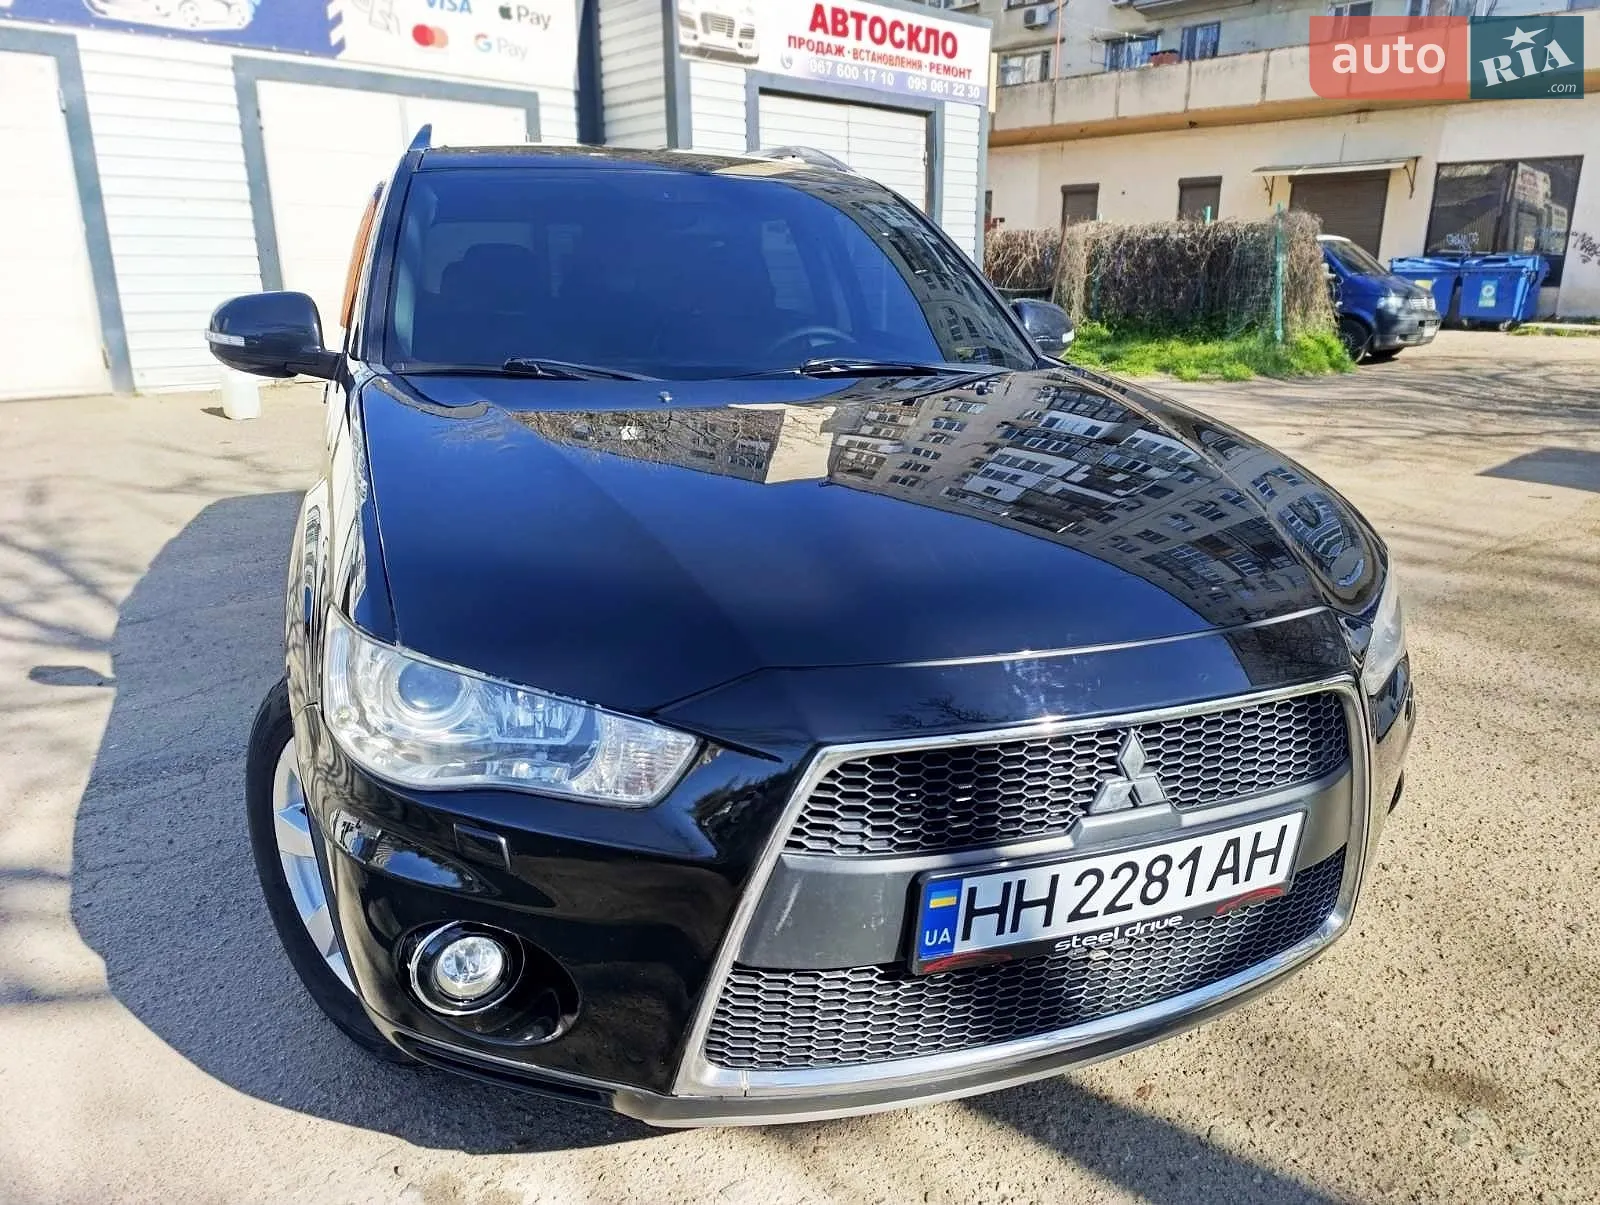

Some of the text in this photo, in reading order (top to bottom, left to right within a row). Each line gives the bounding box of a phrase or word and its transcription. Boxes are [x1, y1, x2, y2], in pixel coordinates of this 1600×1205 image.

[426, 0, 472, 14] VISA
[516, 4, 551, 30] Pay
[496, 36, 528, 61] Pay
[808, 3, 959, 60] АВТОСКЛО
[787, 35, 973, 80] ПРОДАЖ ВСТАНОВЛЕННЯ РЕМОНТ
[836, 64, 859, 80] 600
[863, 68, 877, 83] 17
[881, 71, 895, 86] 10
[952, 83, 965, 97] 22
[967, 85, 981, 99] 30
[961, 824, 1288, 942] HH 2281 AH
[924, 927, 951, 947] UA
[1055, 915, 1183, 952] steel drive
